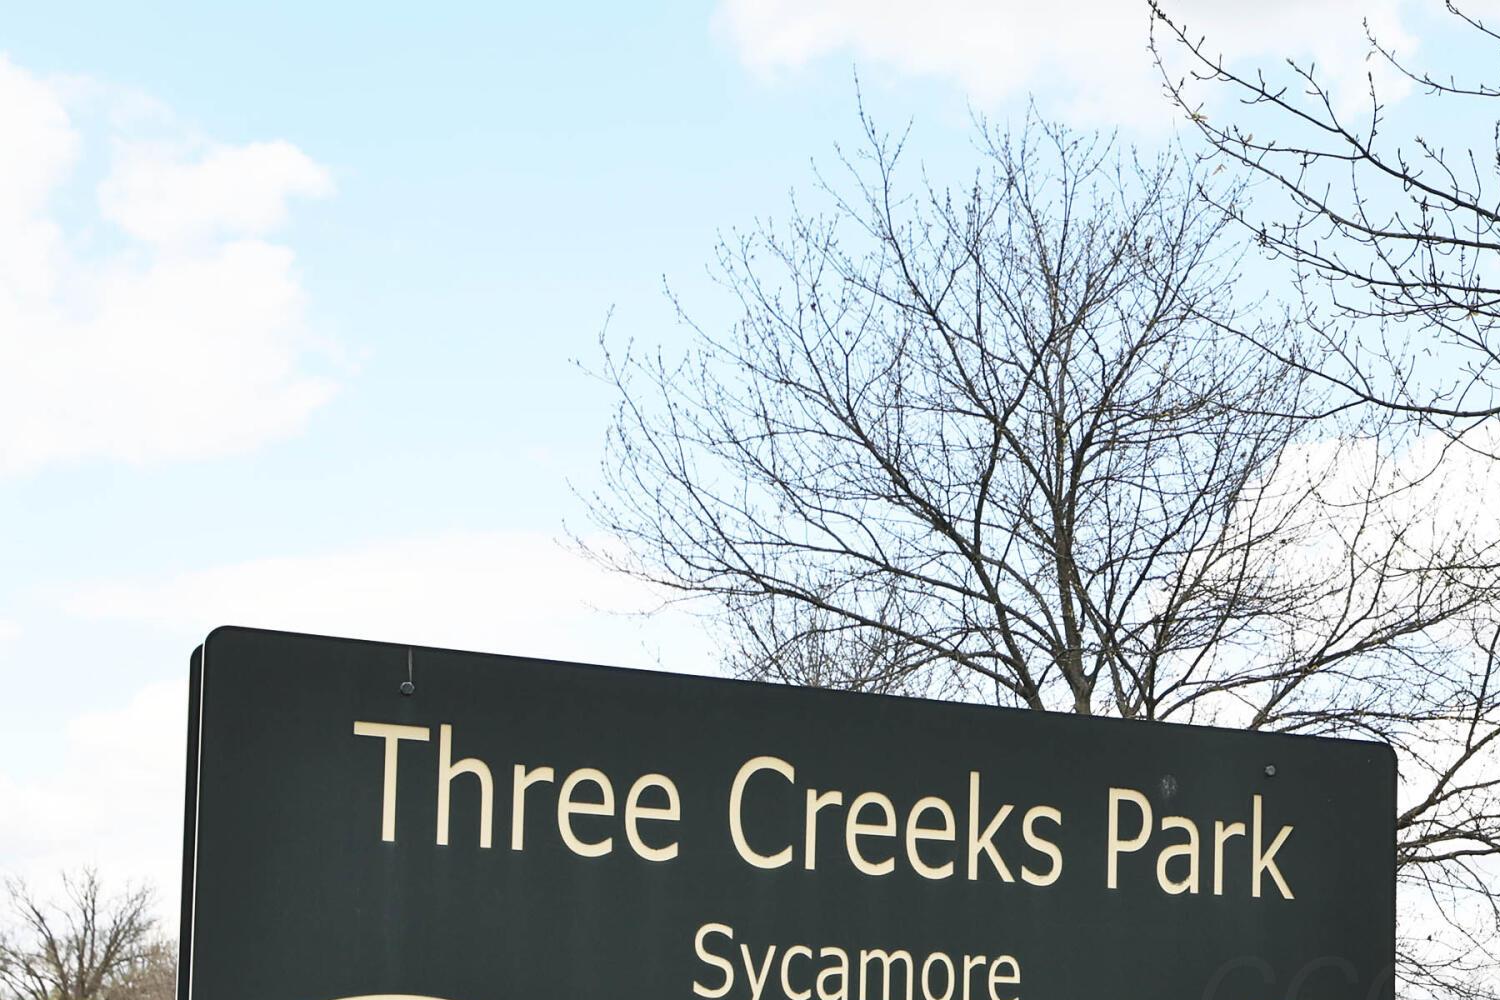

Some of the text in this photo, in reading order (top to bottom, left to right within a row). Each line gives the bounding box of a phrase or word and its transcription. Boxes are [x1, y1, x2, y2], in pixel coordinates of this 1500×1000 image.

[353, 720, 1295, 900] Three Creeks Park
